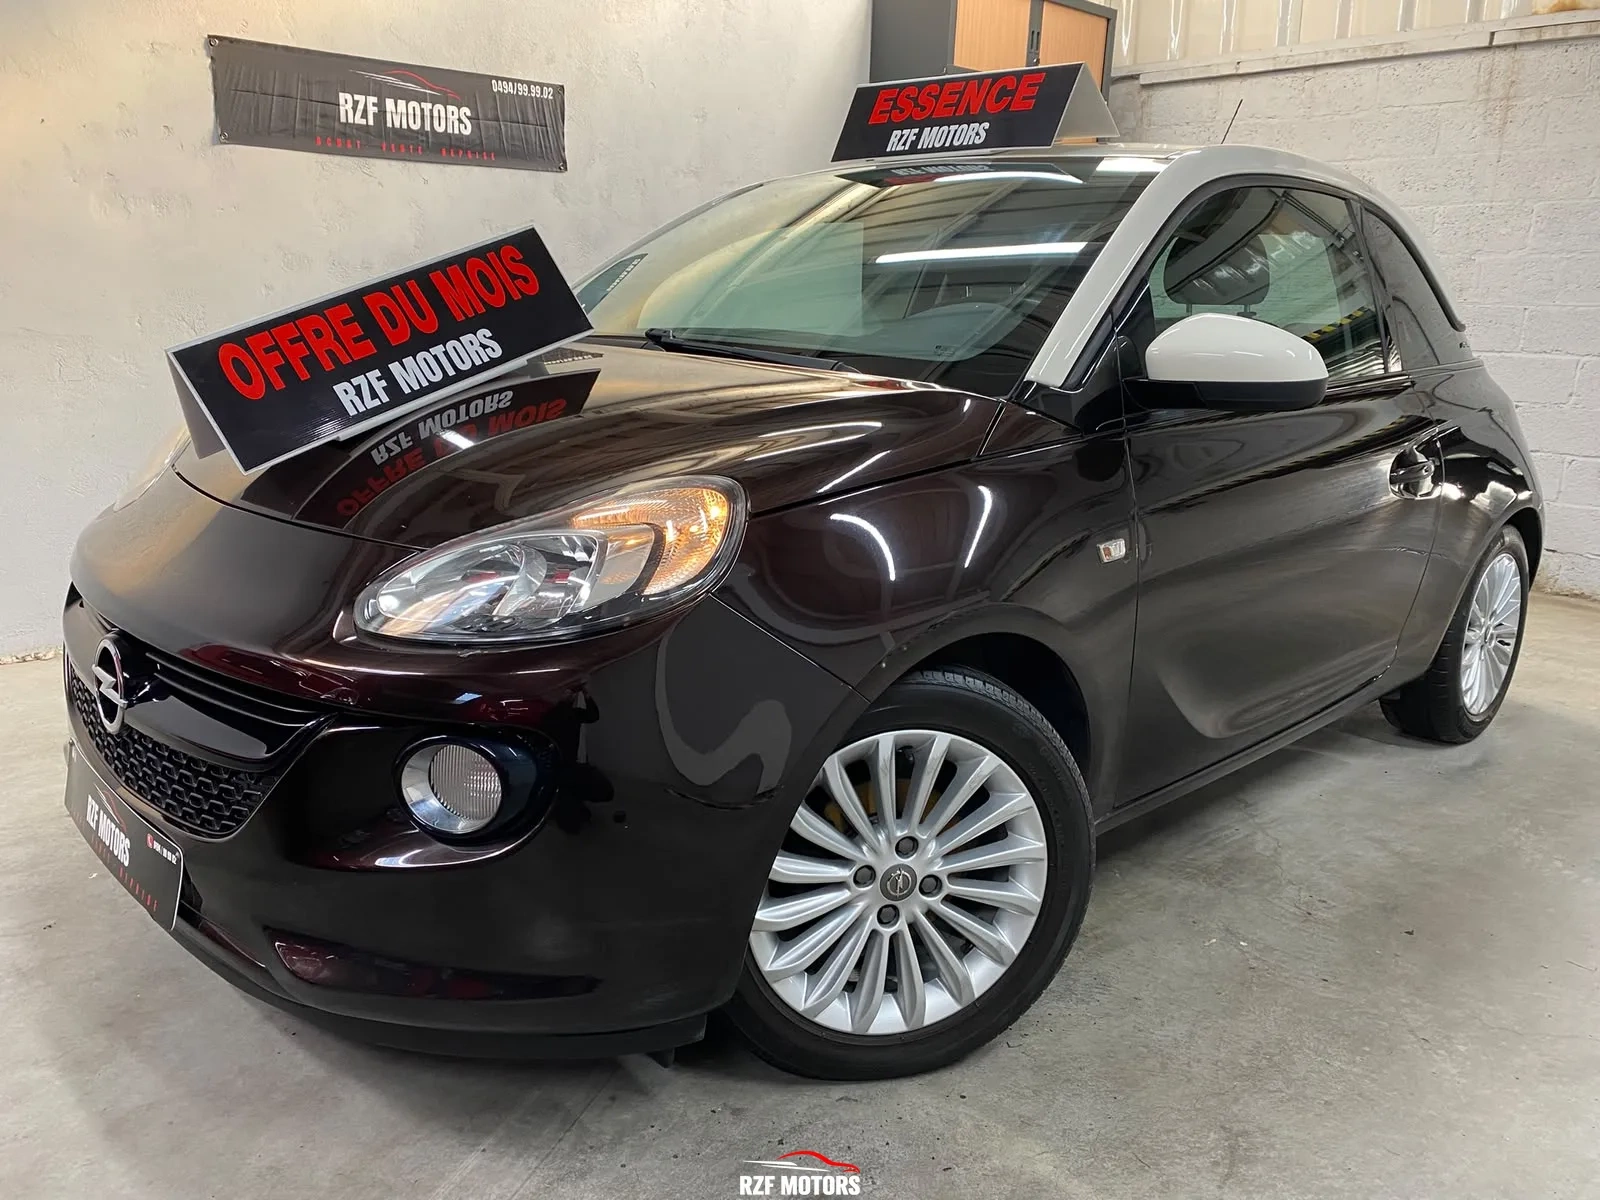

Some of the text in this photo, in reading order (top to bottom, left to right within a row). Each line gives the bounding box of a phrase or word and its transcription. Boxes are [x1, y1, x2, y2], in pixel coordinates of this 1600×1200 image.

[338, 92, 473, 136] RZF MOTORS
[491, 79, 554, 99] 0494/99.99.02
[868, 72, 1046, 125] ESSENCE
[886, 122, 990, 152] RZF MOTORS
[218, 303, 377, 400] OFFRE
[363, 279, 439, 346] DU
[430, 245, 539, 321] MOIS
[333, 328, 503, 417] RZF MOTORS
[86, 794, 99, 830] RZF
[98, 809, 131, 867] MOTORS
